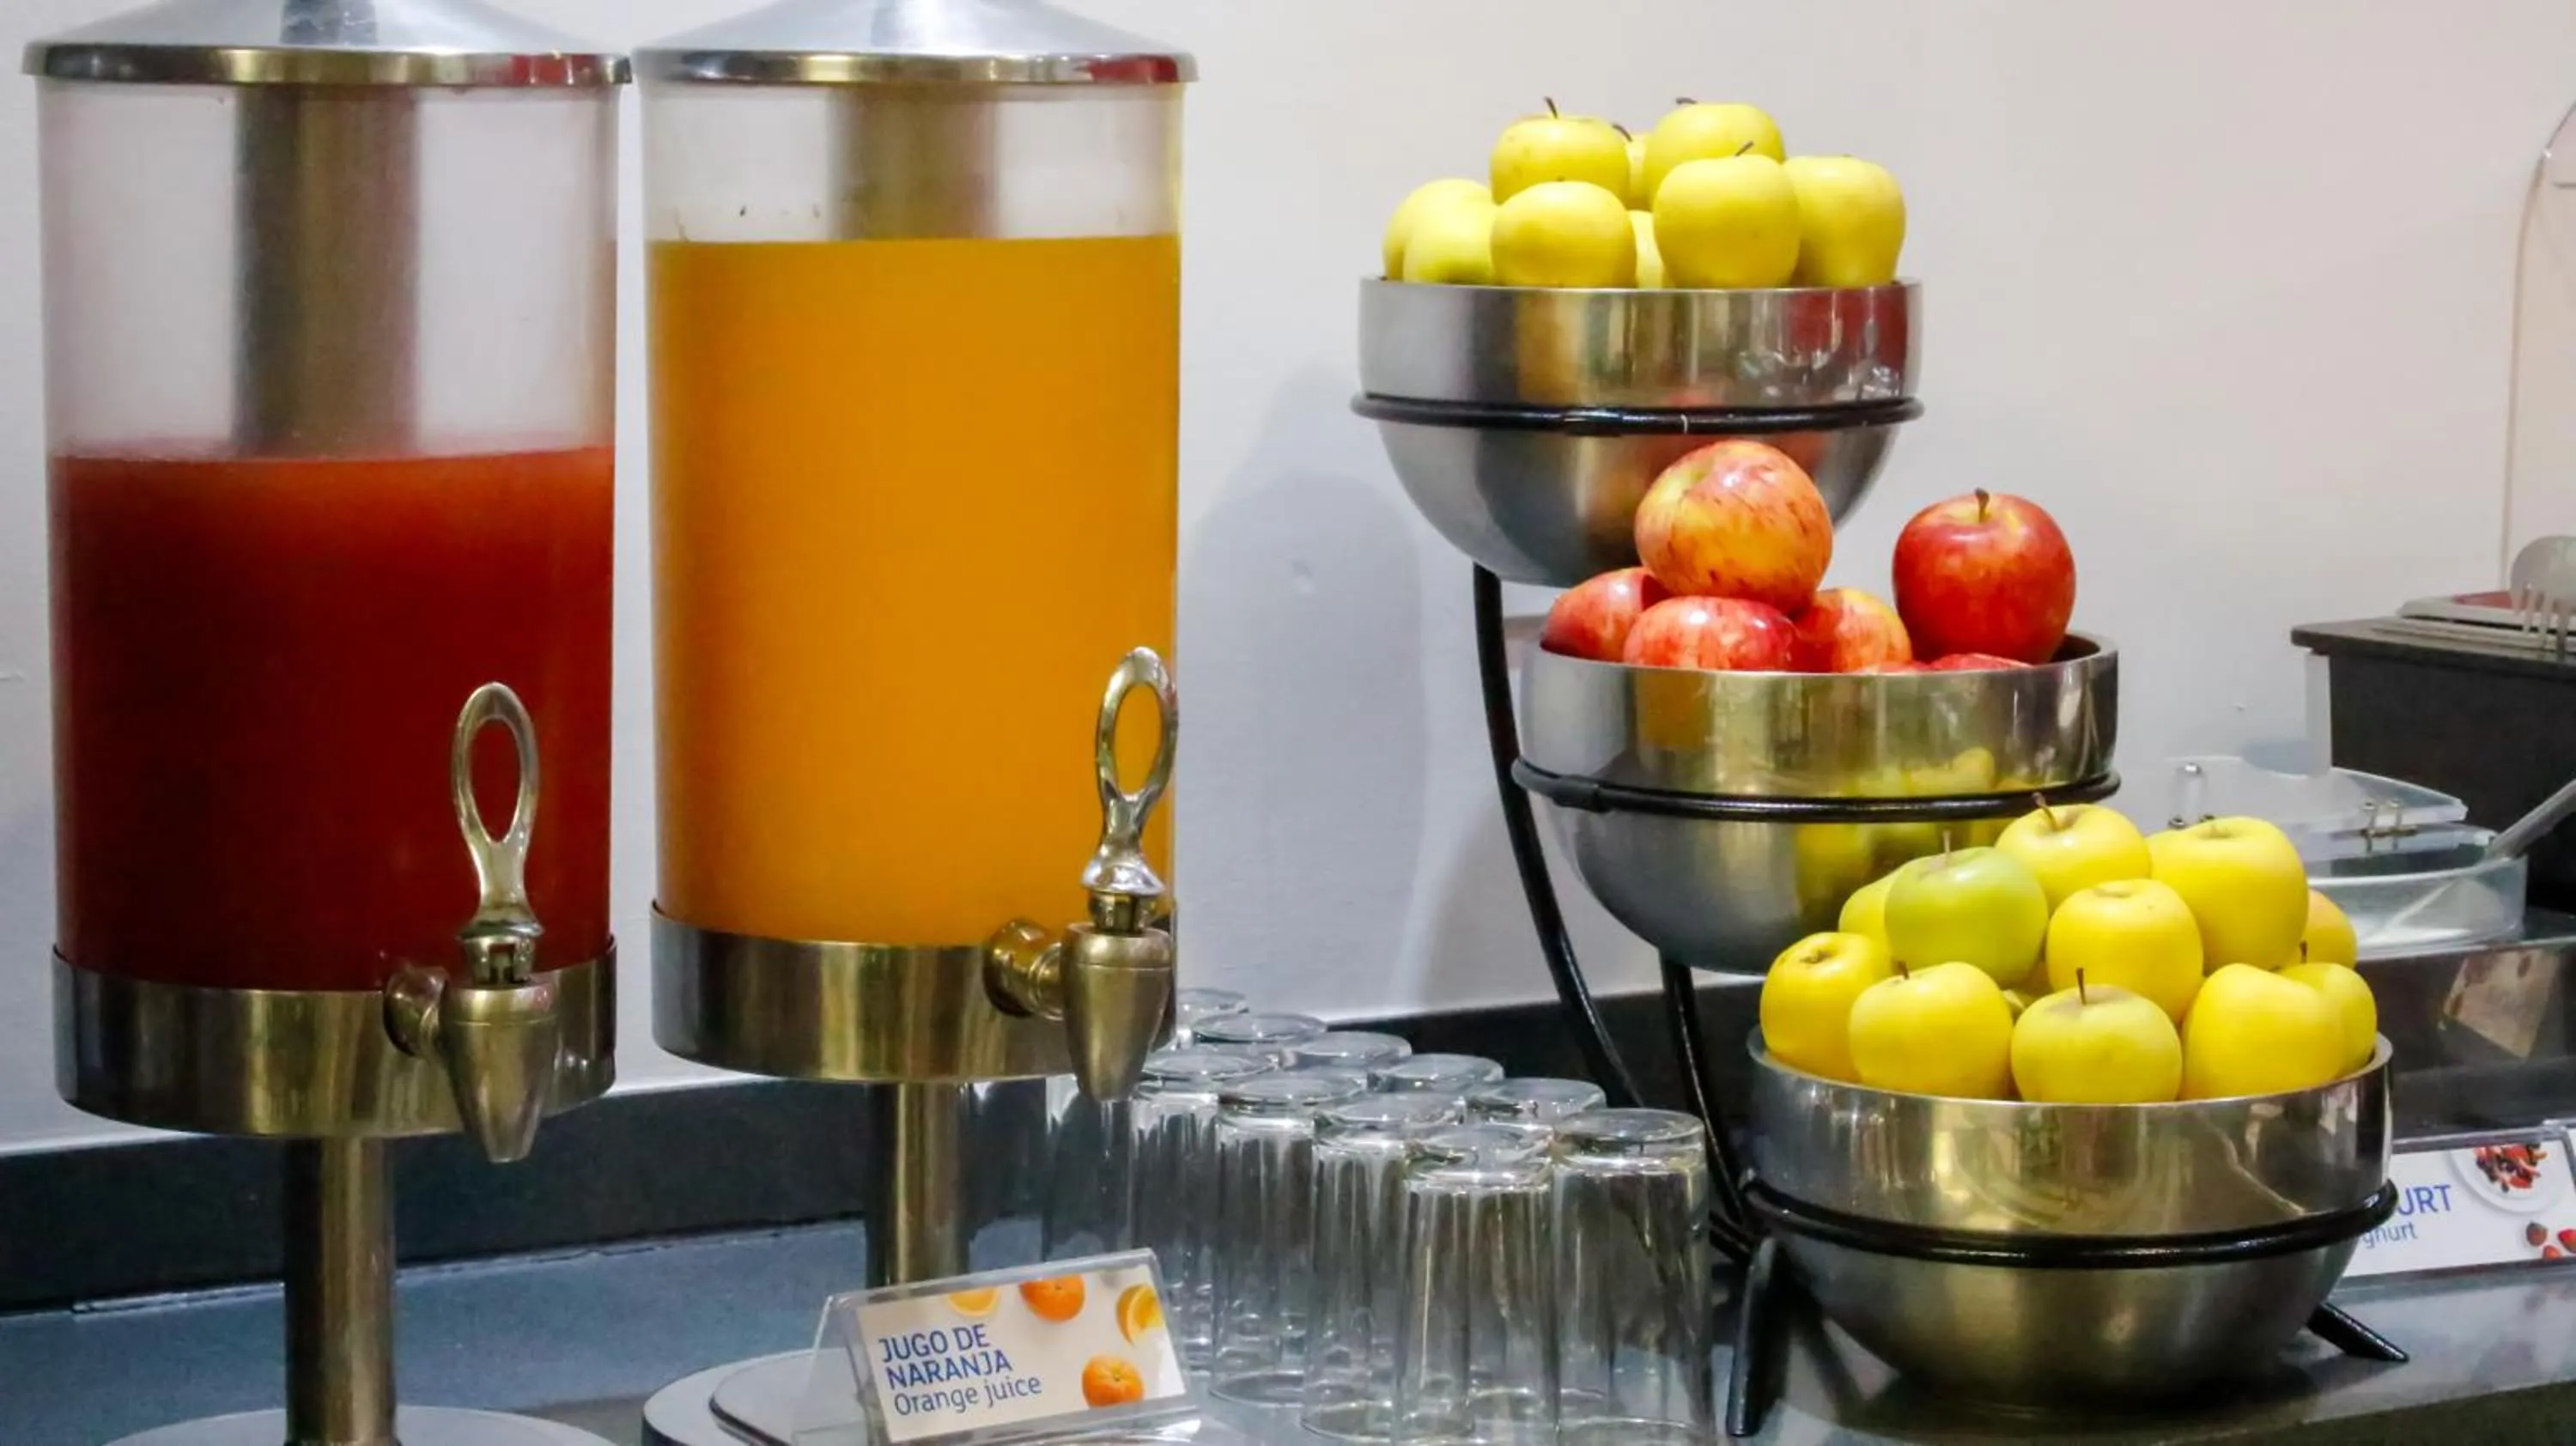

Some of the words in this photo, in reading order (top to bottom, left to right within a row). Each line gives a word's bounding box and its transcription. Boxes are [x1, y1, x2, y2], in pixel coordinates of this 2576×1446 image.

[2398, 1185, 2451, 1215] URT
[2363, 1221, 2418, 1249] ghurt
[878, 1330, 948, 1363] JUGO
[955, 1324, 990, 1350] DE
[885, 1349, 1012, 1389] NARANJA
[894, 1386, 978, 1416] Orange
[984, 1376, 1042, 1408] juice
